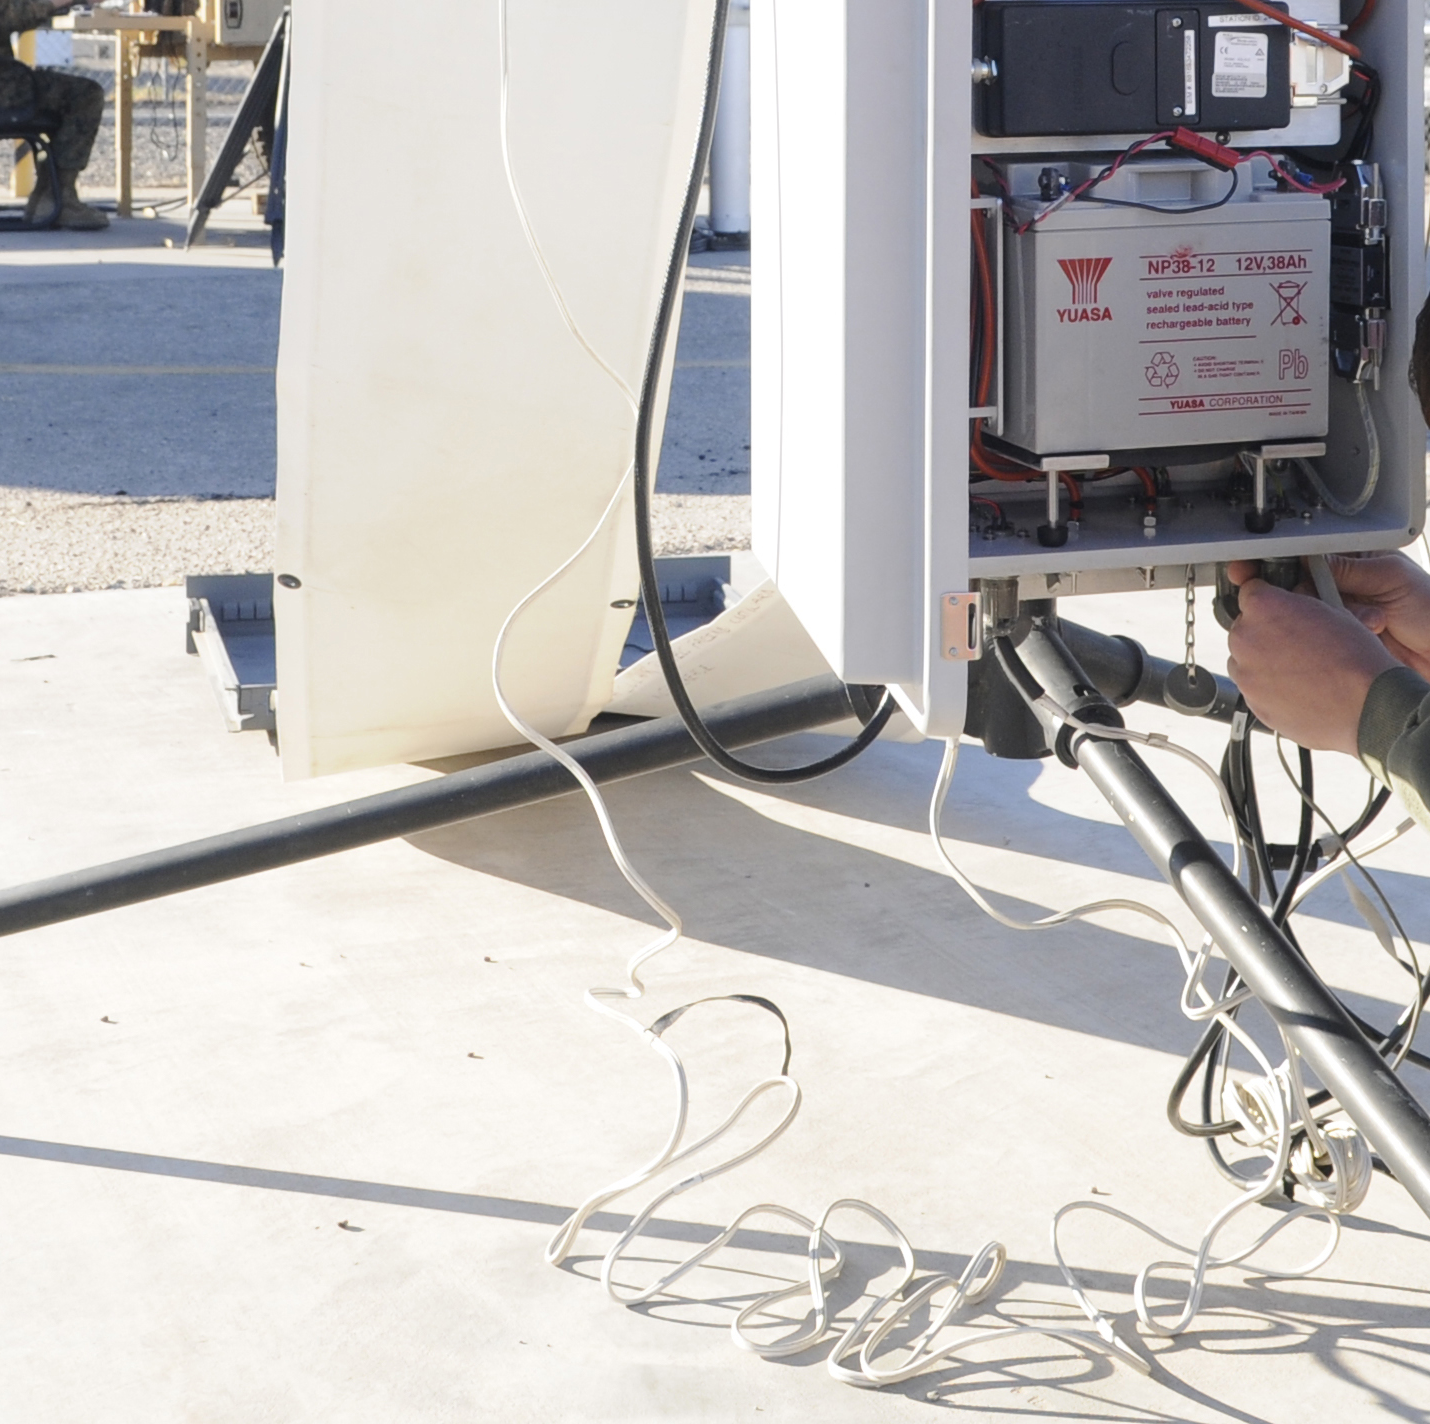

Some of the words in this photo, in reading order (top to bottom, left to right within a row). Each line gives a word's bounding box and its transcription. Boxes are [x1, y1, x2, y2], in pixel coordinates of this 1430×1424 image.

[1148, 258, 1215, 275] NP38-12
[1235, 254, 1307, 274] 12V,38Ah
[1146, 288, 1173, 299] valve
[1176, 285, 1225, 299] regulated
[1056, 307, 1113, 323] YUASA
[1146, 303, 1180, 314] sealed
[1182, 301, 1229, 313] lead-acid
[1231, 301, 1254, 312] type
[1146, 317, 1213, 330] rechargeable
[1216, 315, 1251, 327] battery
[1279, 348, 1309, 381] Pb
[1170, 398, 1205, 410] YUASA
[1209, 394, 1283, 408] CORPORATION
